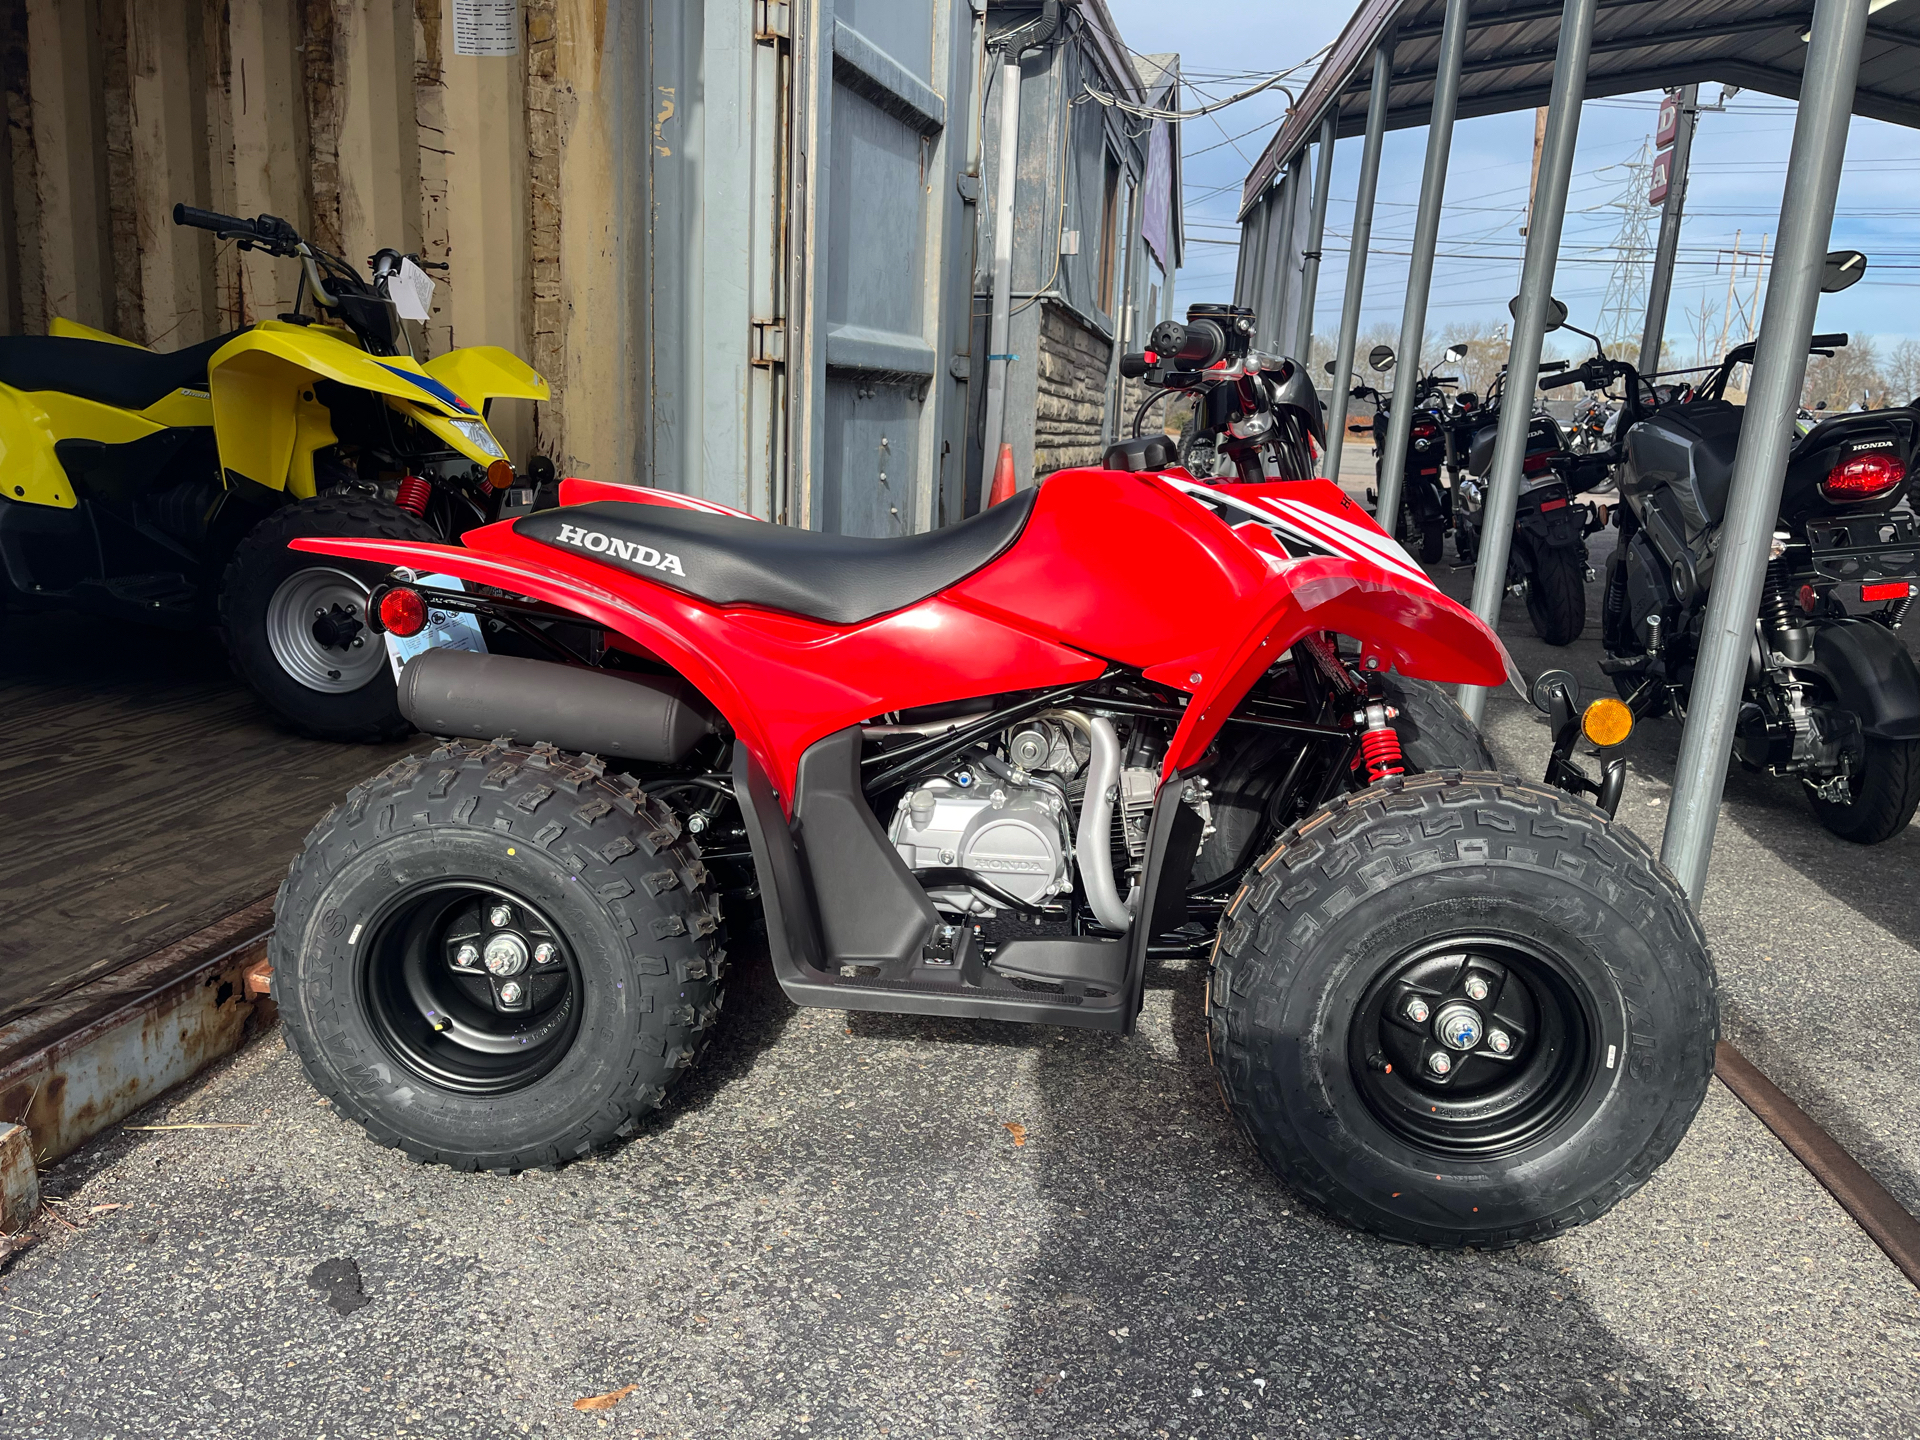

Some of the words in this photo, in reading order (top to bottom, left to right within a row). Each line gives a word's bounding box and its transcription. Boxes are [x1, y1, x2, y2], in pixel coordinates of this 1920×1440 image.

[1852, 441, 1894, 451] HONDA
[556, 523, 686, 577] HONDA
[974, 859, 1045, 872] HONDA
[310, 907, 384, 1095] MAXXIS
[1538, 898, 1656, 1082] MAXXIS
